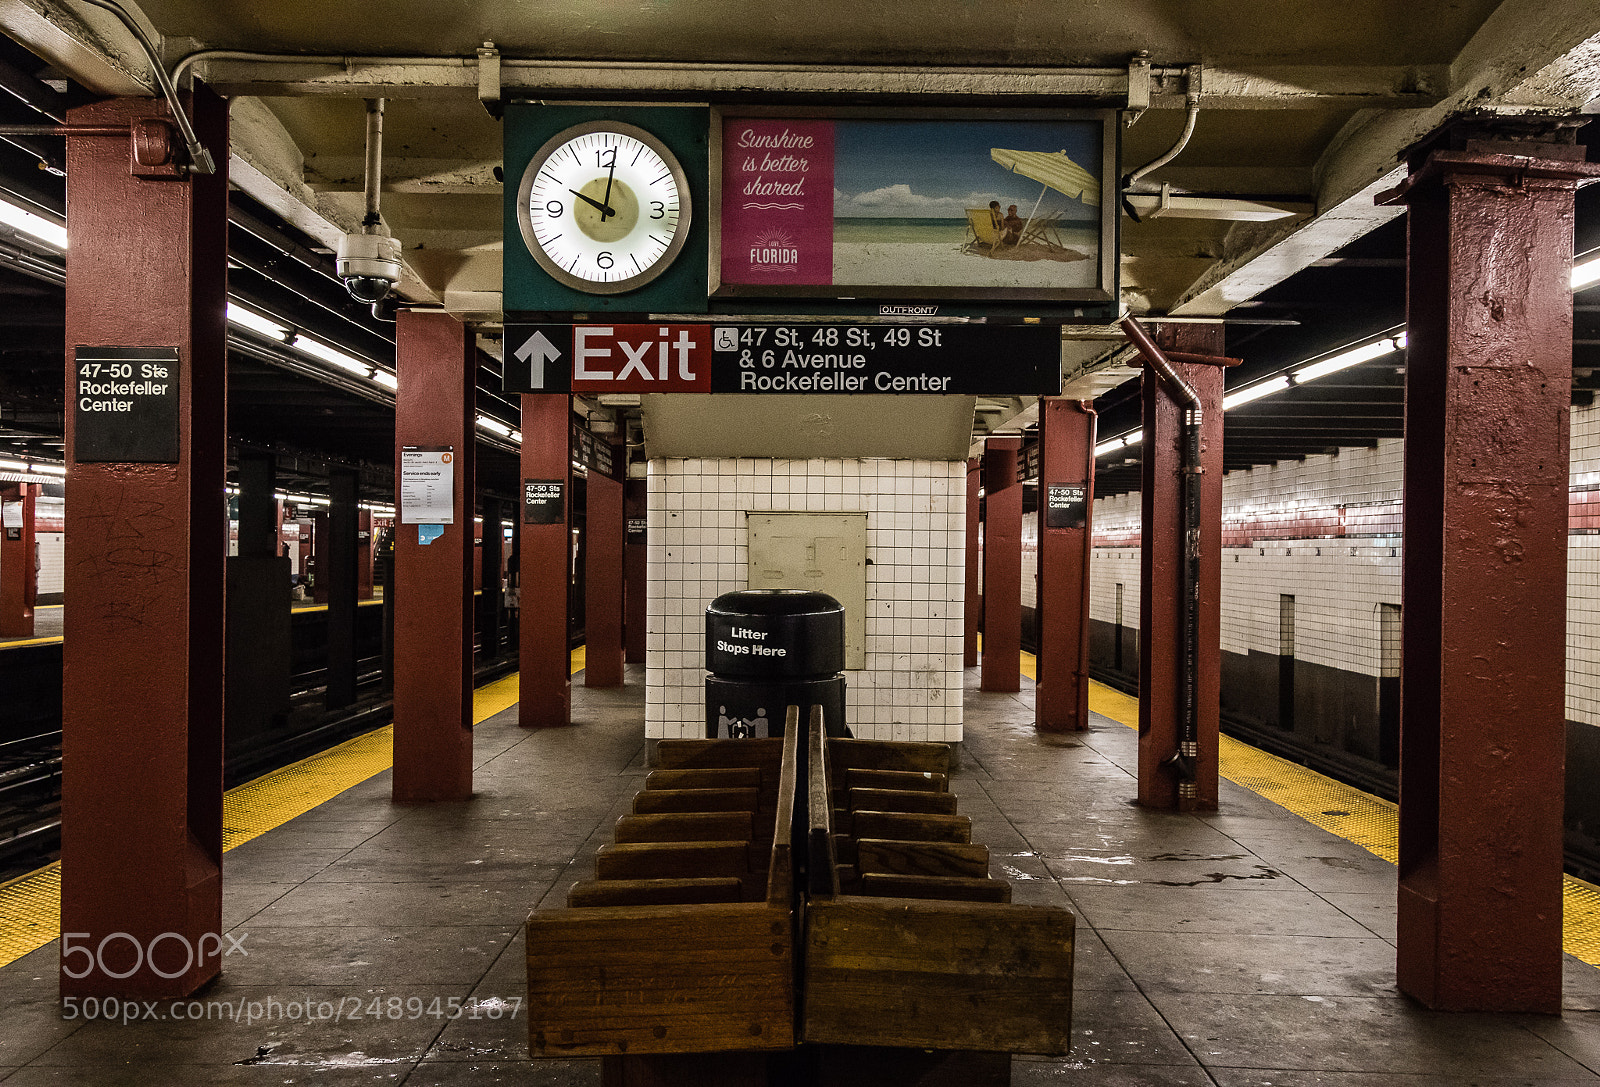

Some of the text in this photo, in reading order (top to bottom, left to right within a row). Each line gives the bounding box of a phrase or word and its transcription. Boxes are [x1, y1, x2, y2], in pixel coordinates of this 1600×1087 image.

[738, 128, 815, 149] Sunshine
[595, 149, 617, 168] 12
[742, 152, 810, 172] is better
[743, 176, 805, 196] shared.
[546, 200, 564, 218] 9
[649, 201, 665, 219] 3
[596, 251, 614, 269] 6
[750, 248, 798, 264] FLORIDA
[882, 306, 935, 314] OUTFRONT
[740, 327, 942, 350] 47 St, 48 St, 49 St
[574, 326, 697, 381] Exit
[739, 350, 867, 369] & 6 Avenue
[79, 363, 169, 379] 47-50 Sts
[79, 380, 169, 395] Rockefeller
[740, 371, 951, 391] Rockefeller Center
[79, 397, 134, 412] Center
[1049, 495, 1084, 503] Rockefeller
[1049, 501, 1070, 509] Center
[731, 626, 768, 640] Litter
[716, 640, 787, 657] Stops Here
